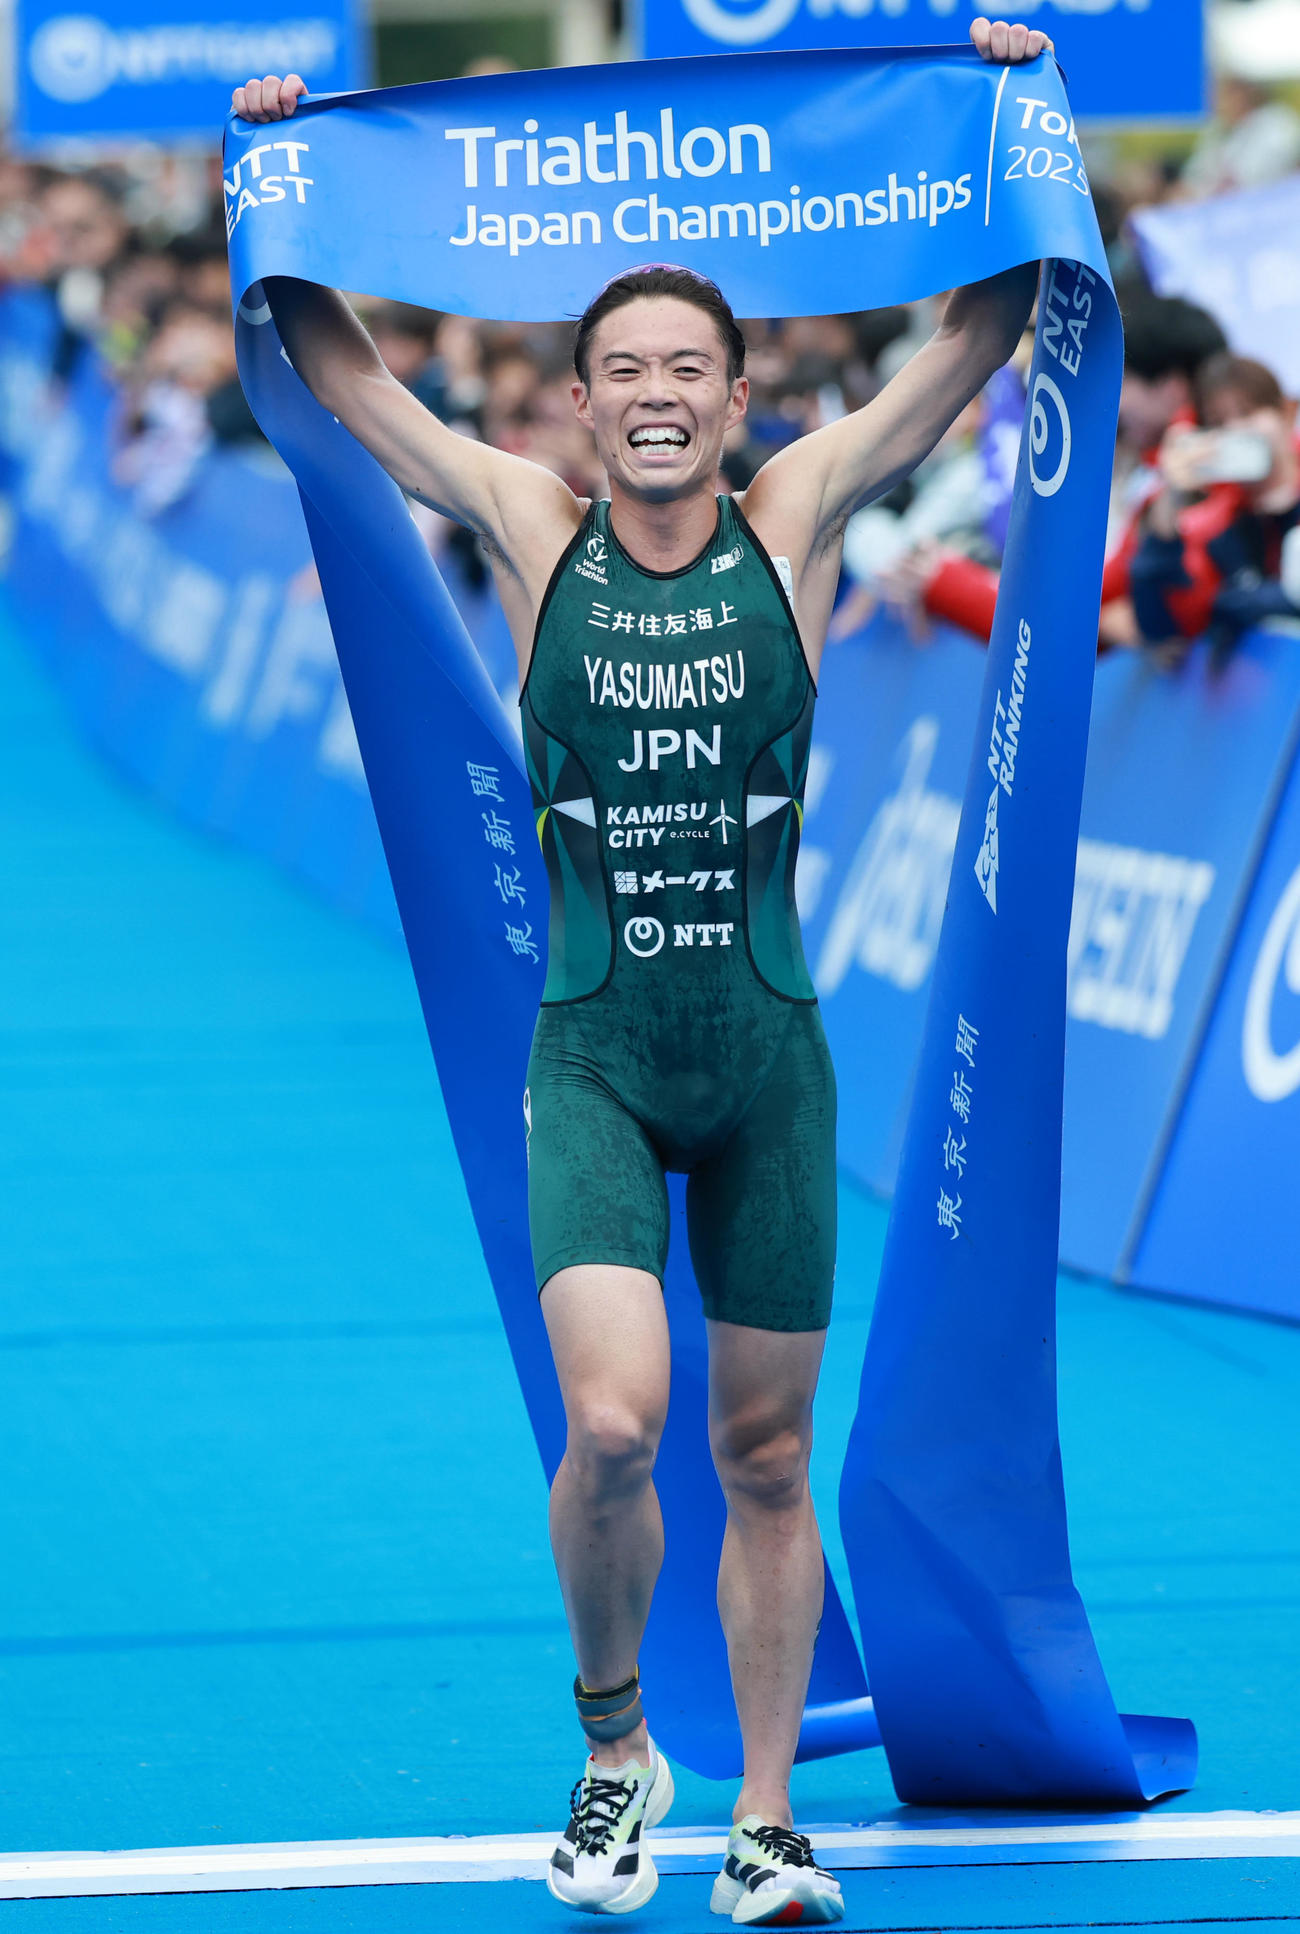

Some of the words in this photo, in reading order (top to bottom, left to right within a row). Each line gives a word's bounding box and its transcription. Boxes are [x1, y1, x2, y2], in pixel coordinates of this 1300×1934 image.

[444, 108, 771, 188] Triathlon
[1004, 145, 1089, 196] 2025
[226, 175, 314, 242] EAST
[448, 205, 602, 256] Japan
[612, 170, 972, 246] Championships
[1059, 262, 1096, 377] EAST
[574, 564, 609, 585] Triathlon
[582, 559, 606, 574] World
[588, 601, 738, 636] 三井住友海上
[583, 650, 745, 710] YASUMATSU
[999, 618, 1032, 796] RANKING
[617, 724, 722, 773] JPN
[987, 689, 1006, 781] NTT
[606, 802, 707, 826] KAMISU
[607, 827, 665, 849] CITY
[642, 869, 735, 893] メークス
[673, 922, 734, 947] NTT
